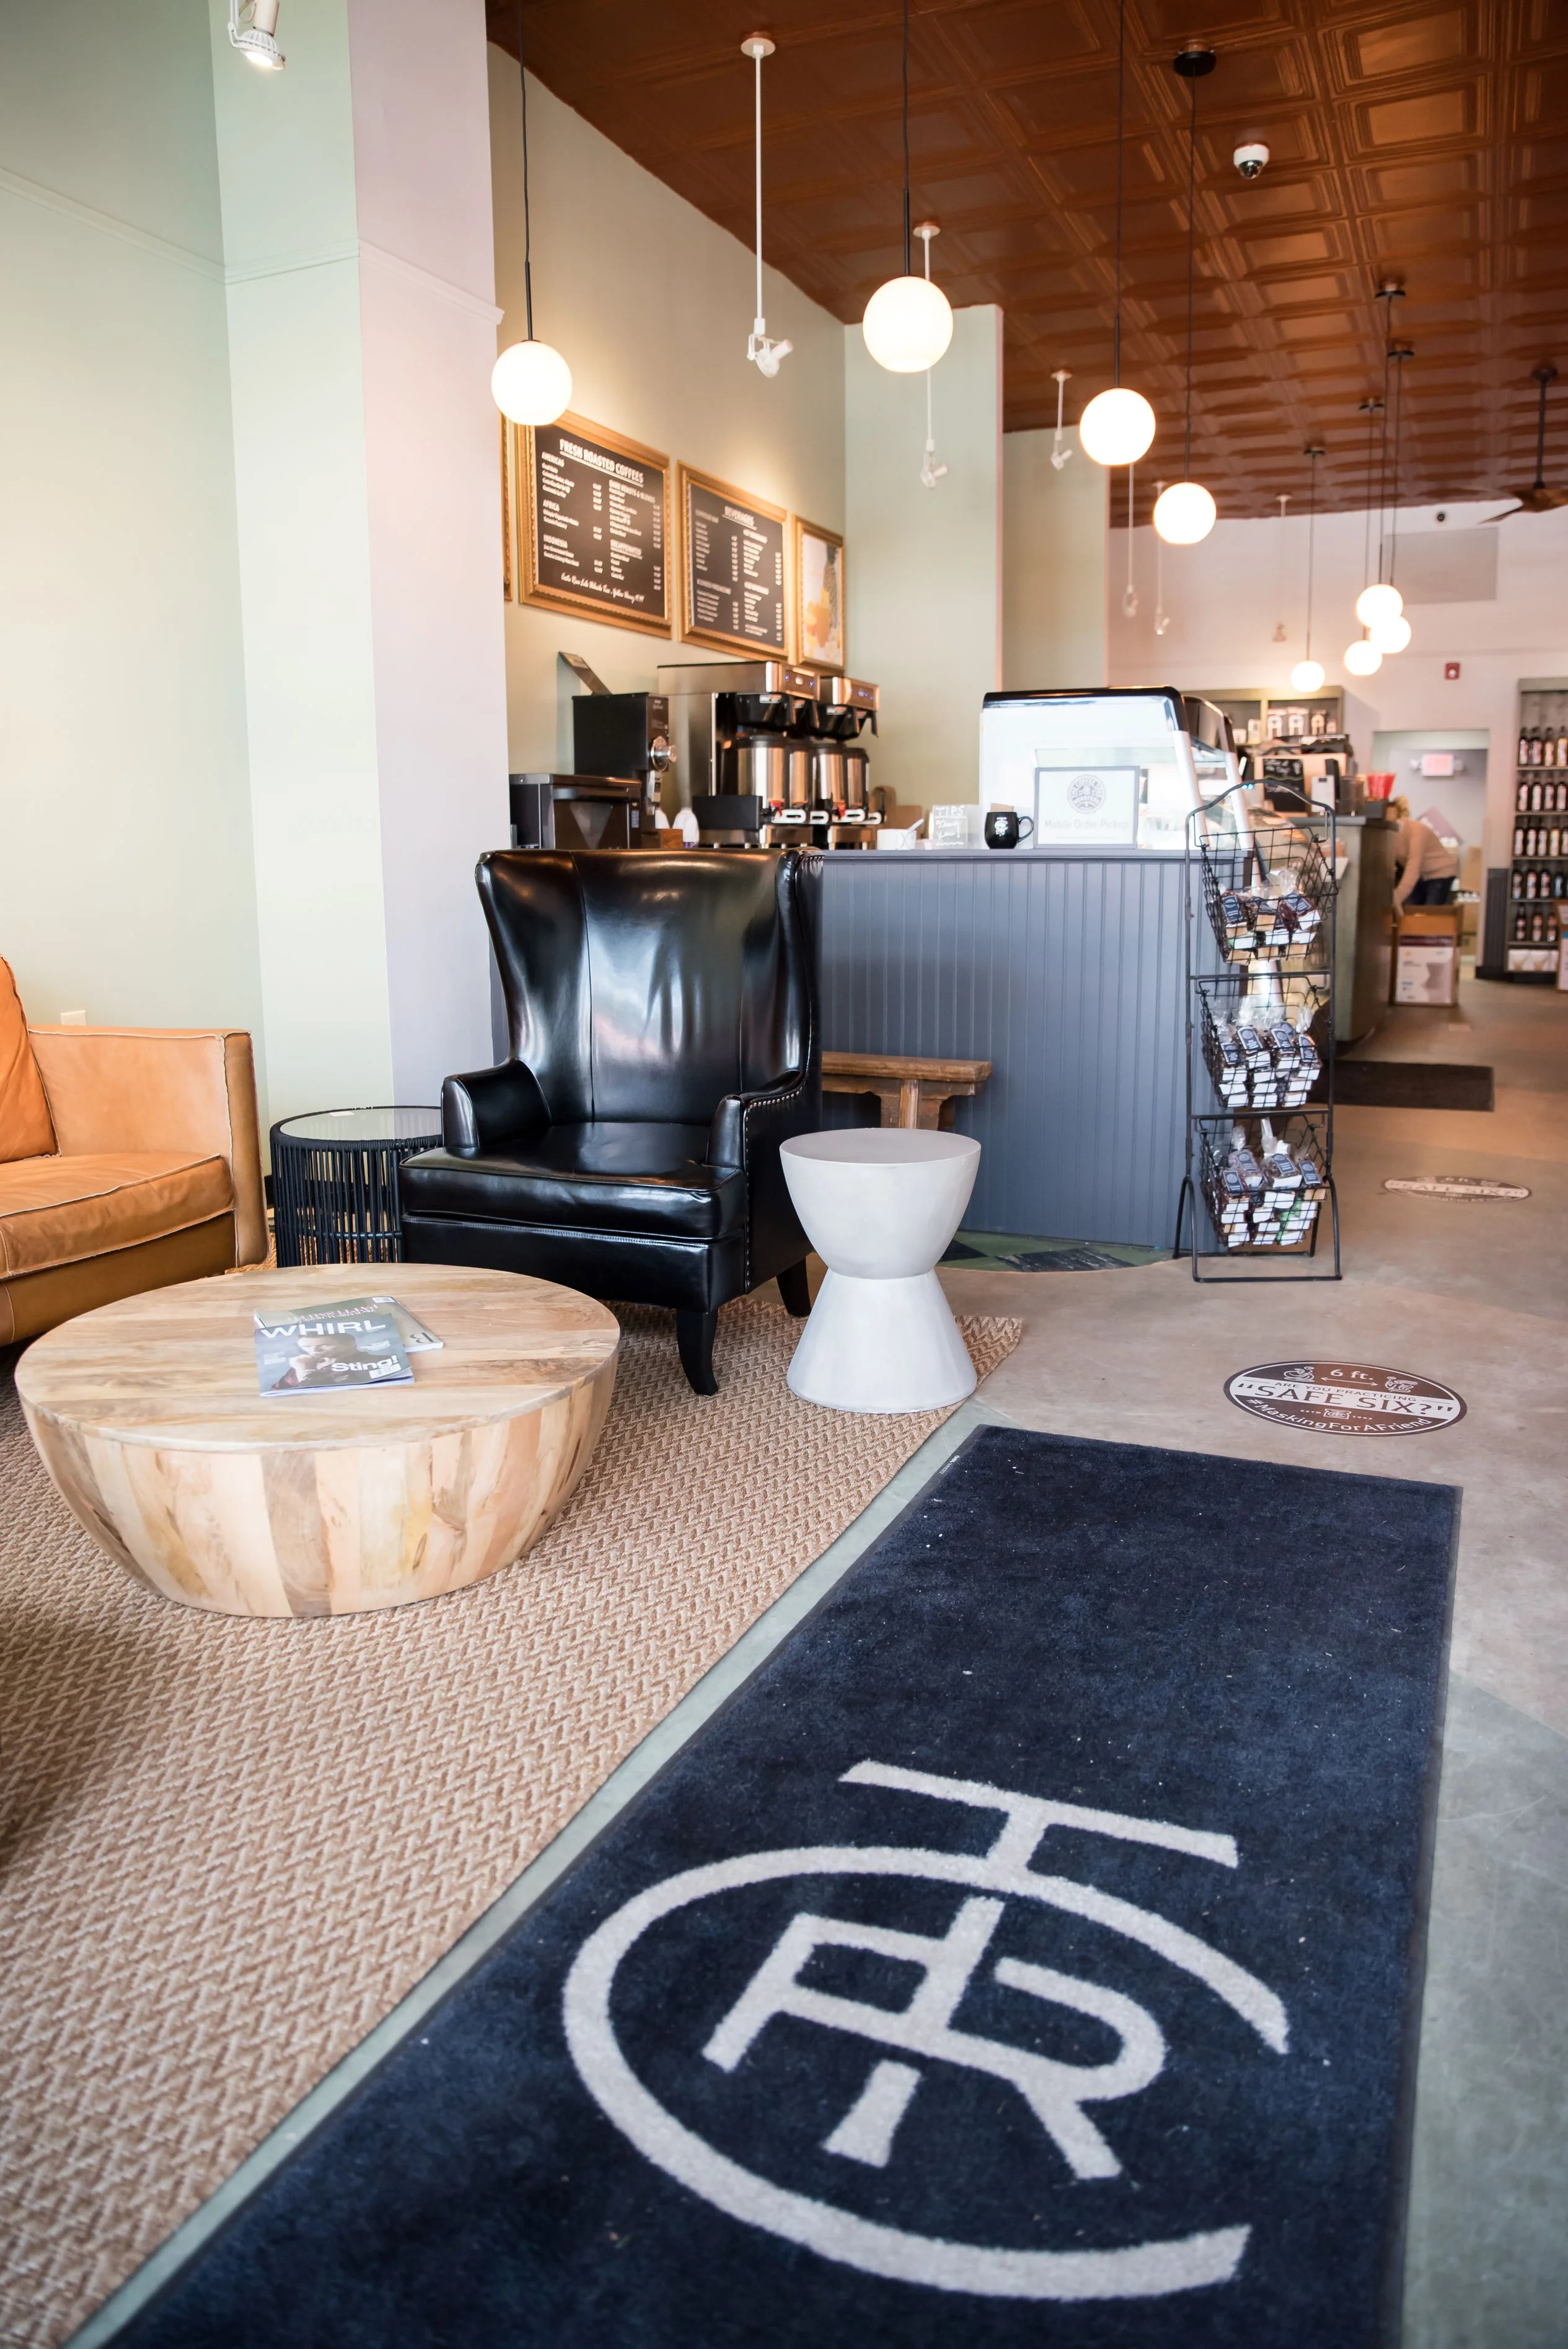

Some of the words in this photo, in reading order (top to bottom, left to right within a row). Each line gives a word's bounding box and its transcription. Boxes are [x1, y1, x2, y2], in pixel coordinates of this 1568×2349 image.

[560, 438, 583, 459] FRESH
[583, 448, 615, 472] ROASTED
[615, 463, 644, 484] COFFEES
[935, 805, 964, 816] TIPS
[1044, 819, 1071, 829] Mobile
[1074, 819, 1097, 829] Order
[1100, 819, 1129, 832] Pickup
[260, 1320, 386, 1338] WHIRL
[332, 1355, 399, 1372] Sting!
[1330, 1368, 1344, 1378] 6
[1351, 1370, 1375, 1381] ft.
[1306, 1384, 1331, 1392] YOU
[1337, 1388, 1417, 1402] PRACTICING
